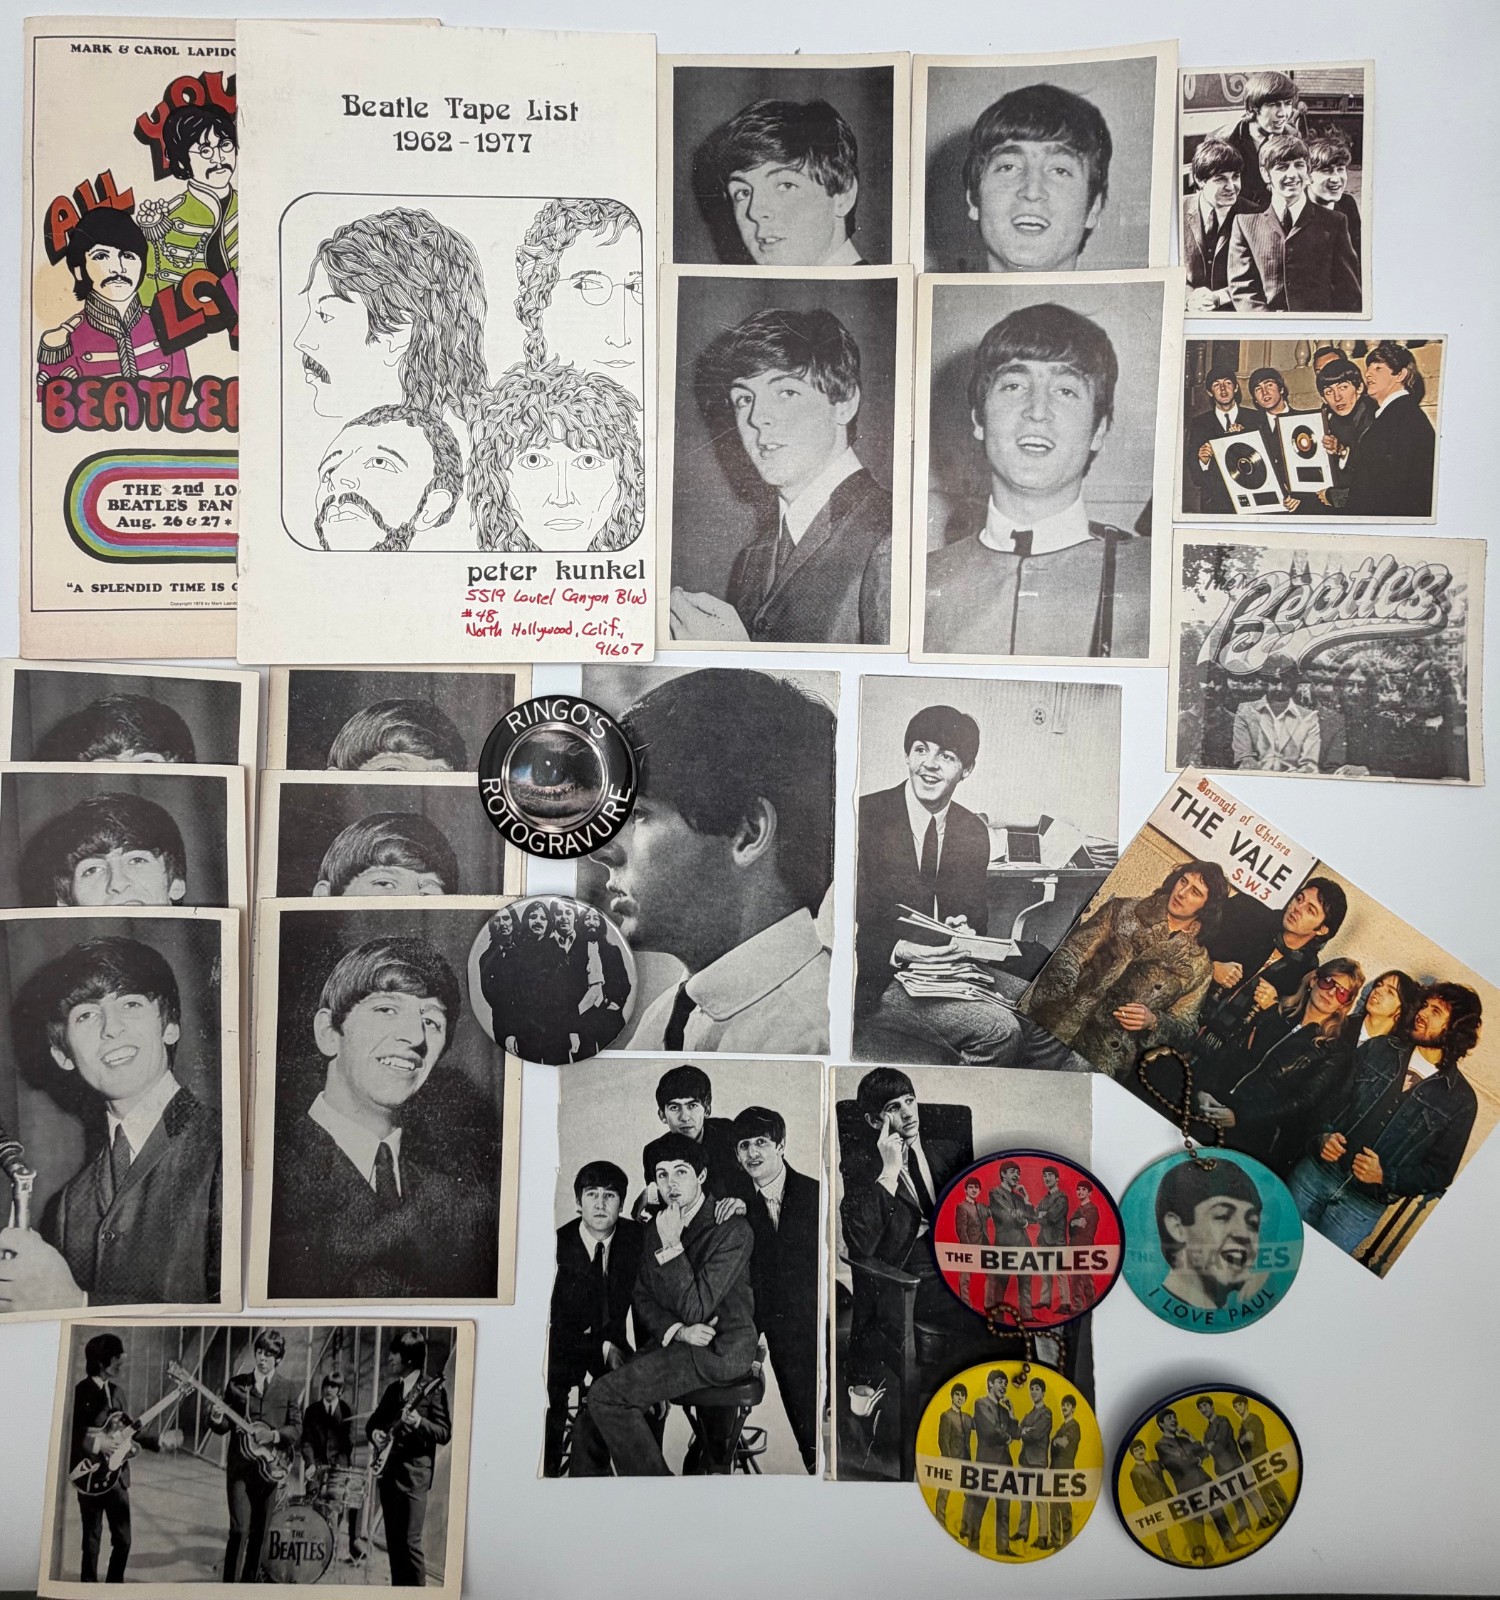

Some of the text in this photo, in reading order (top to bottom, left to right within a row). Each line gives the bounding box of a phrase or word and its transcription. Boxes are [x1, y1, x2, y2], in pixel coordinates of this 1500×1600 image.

[70, 43, 113, 54] MARK
[118, 44, 130, 55] &
[134, 45, 180, 56] CAROL
[341, 94, 579, 124] Beatle Tape List
[44, 168, 136, 266] ALL
[122, 484, 162, 496] THE
[171, 482, 204, 497] 2nd
[107, 499, 233, 511] BEATLES FAN
[116, 516, 221, 529] Aug. 26 & 27
[91, 582, 163, 593] SPLENDID
[169, 582, 206, 592] TIME
[211, 582, 225, 592] IS
[467, 559, 646, 587] peter kunkel
[465, 588, 506, 603] 5519
[562, 588, 609, 611] Canyon
[1197, 553, 1452, 675] Beatles
[465, 622, 502, 637] North
[595, 641, 644, 655] 91607
[505, 699, 612, 739] RINGO'S
[481, 777, 632, 855] ROTOGRAVURE
[1197, 777, 1292, 856] Borough of Chelsea
[1169, 786, 1293, 891] THE VALE
[1231, 868, 1273, 901] S.W.3
[945, 1249, 1109, 1271] THE BEATLES
[1148, 1287, 1274, 1325] I LOVE PAUL
[924, 1464, 1087, 1497] THE BEATLES
[1135, 1451, 1288, 1529] THE BEATLES
[268, 1530, 325, 1566] BEATLES
[291, 1529, 305, 1538] THE
